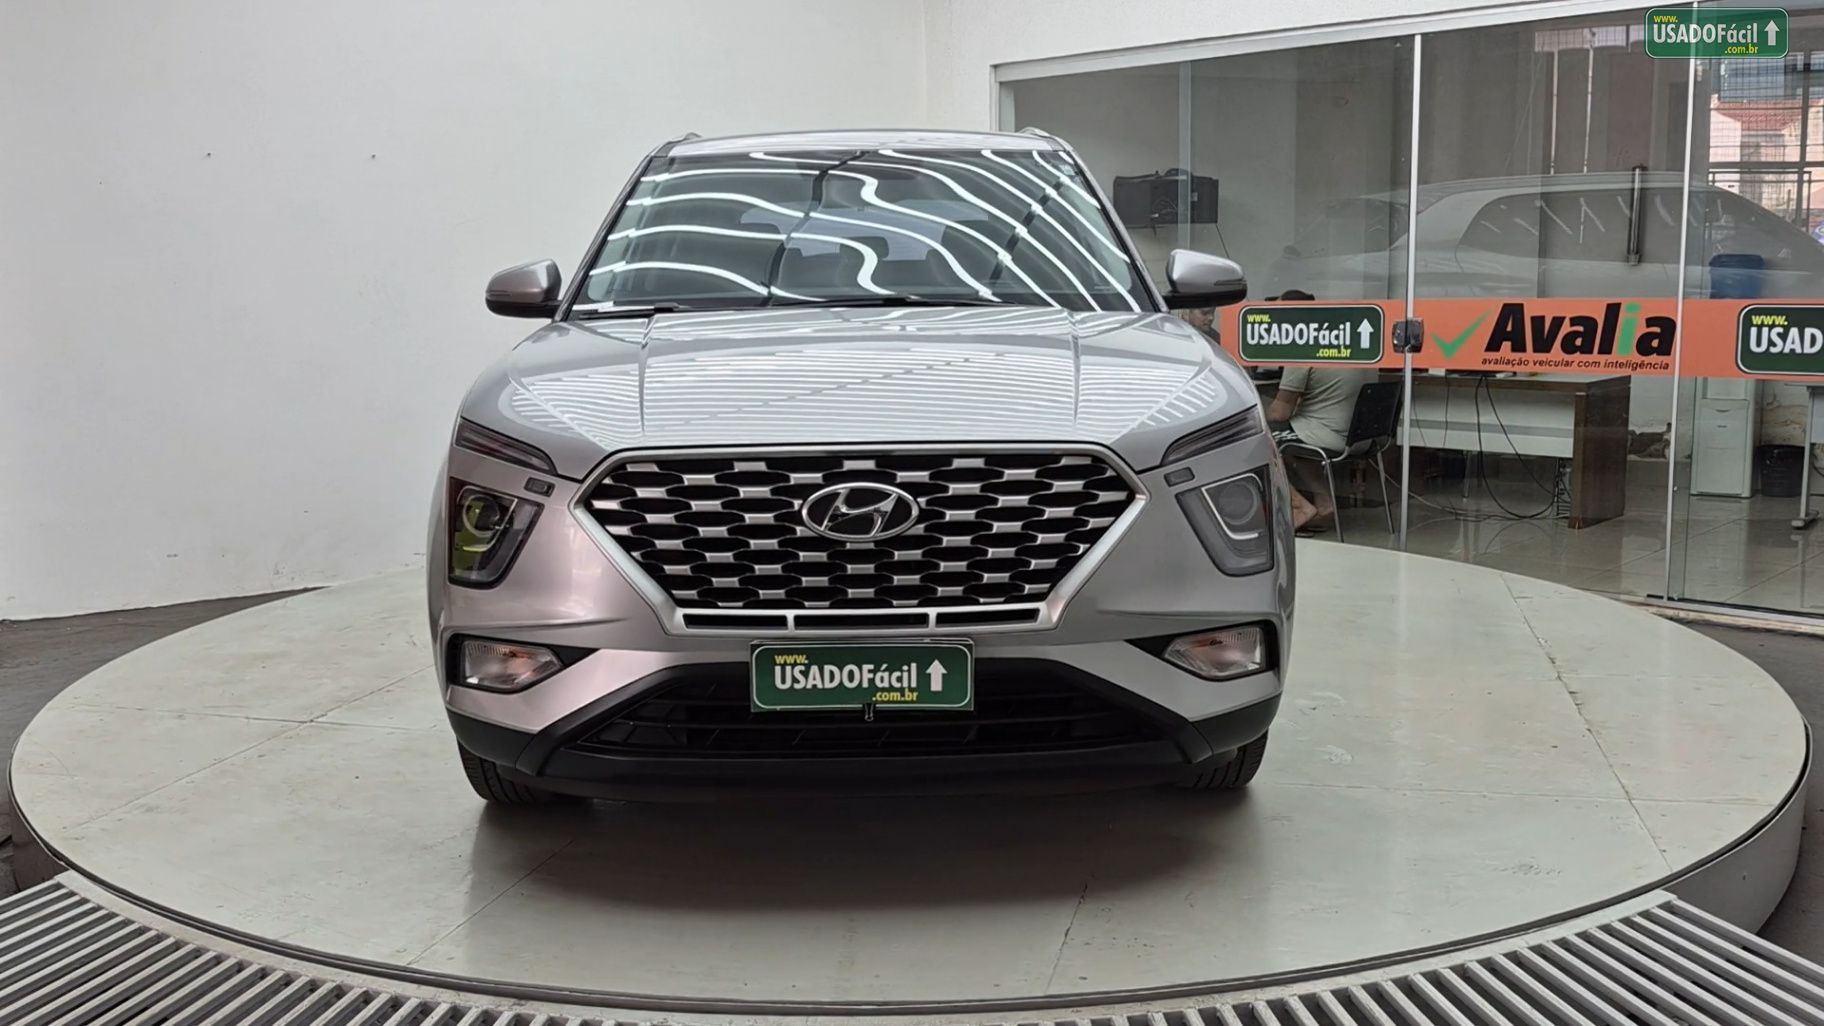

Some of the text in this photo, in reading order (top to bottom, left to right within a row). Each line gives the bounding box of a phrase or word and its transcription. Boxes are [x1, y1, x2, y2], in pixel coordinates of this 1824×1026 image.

[1247, 314, 1271, 322] www.
[1751, 315, 1788, 325] www.
[1246, 321, 1351, 346] USADOFácil
[1484, 302, 1677, 357] Avalia
[1316, 347, 1351, 358] .com.br
[1532, 358, 1574, 368] veicular
[1577, 359, 1601, 369] com
[774, 654, 809, 664] www.
[774, 662, 917, 690] USADOFácil
[872, 688, 918, 701] .com.br
